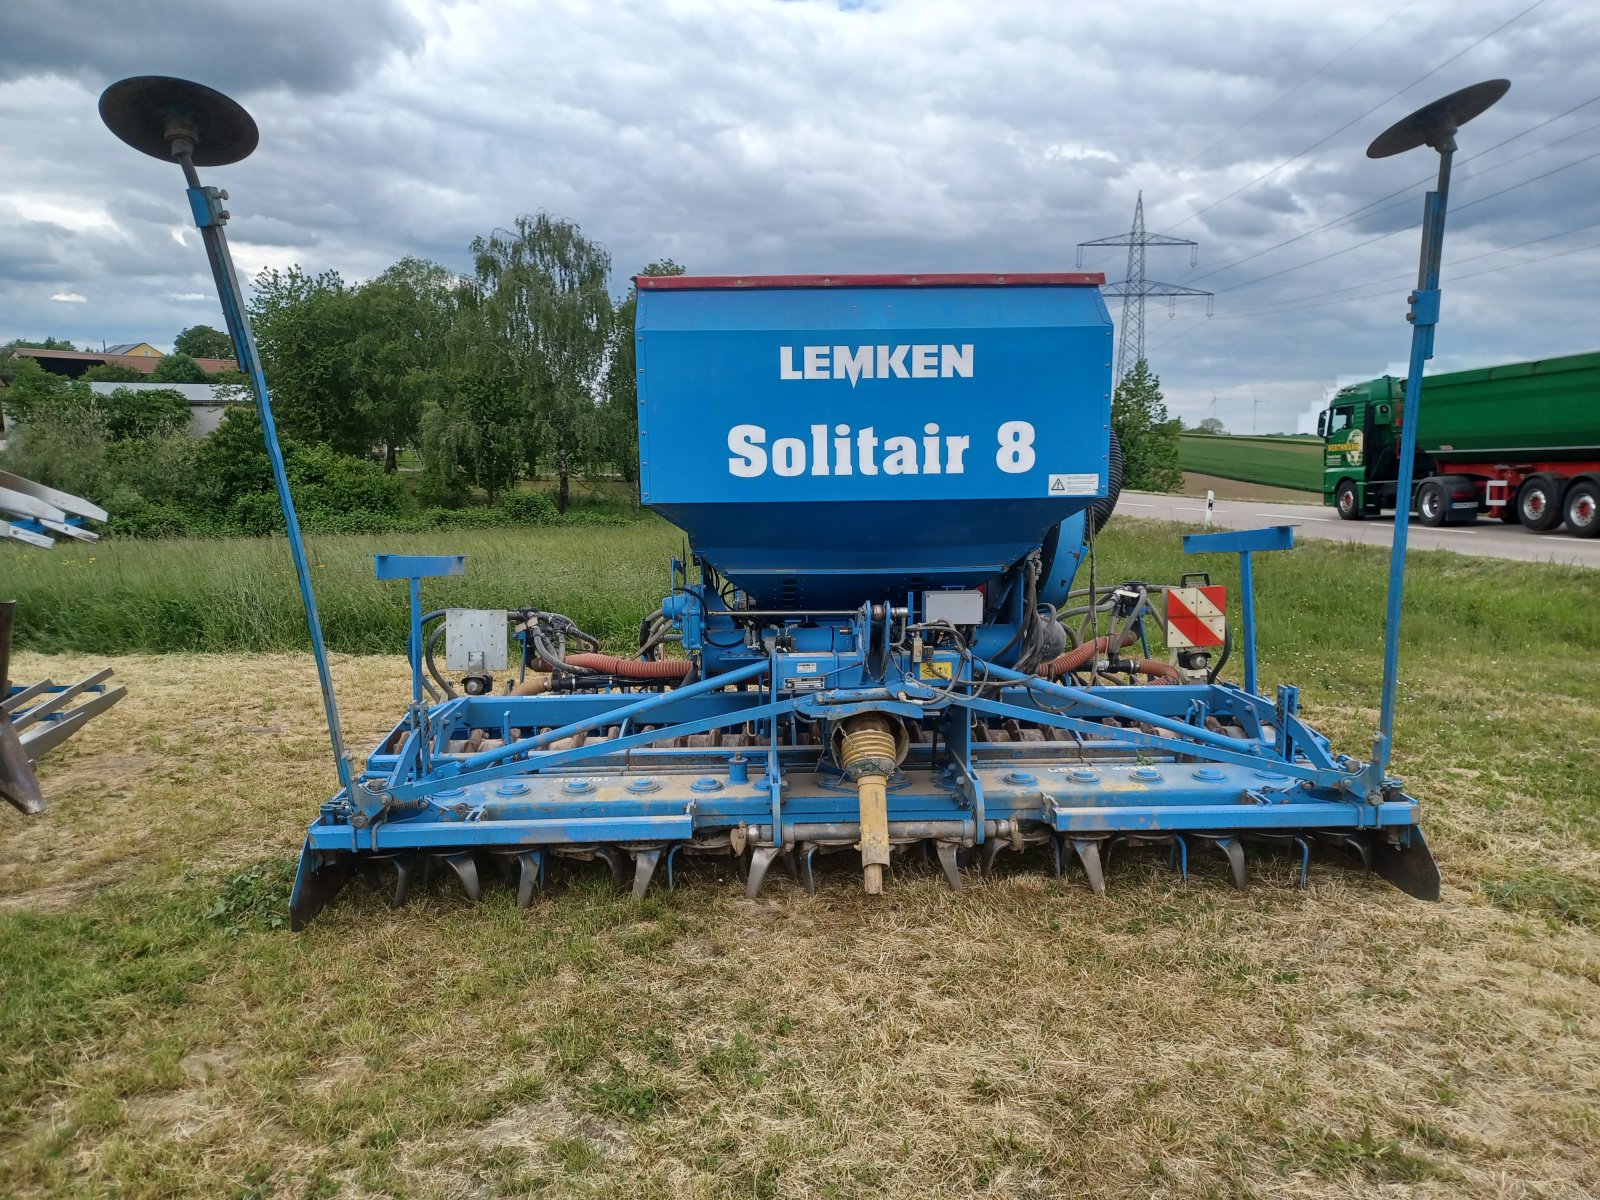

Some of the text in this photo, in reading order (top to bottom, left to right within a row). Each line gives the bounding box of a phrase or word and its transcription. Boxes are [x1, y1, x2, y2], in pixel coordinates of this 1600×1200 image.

[780, 344, 974, 388] LEMKEN
[728, 420, 1036, 478] Solitair 8
